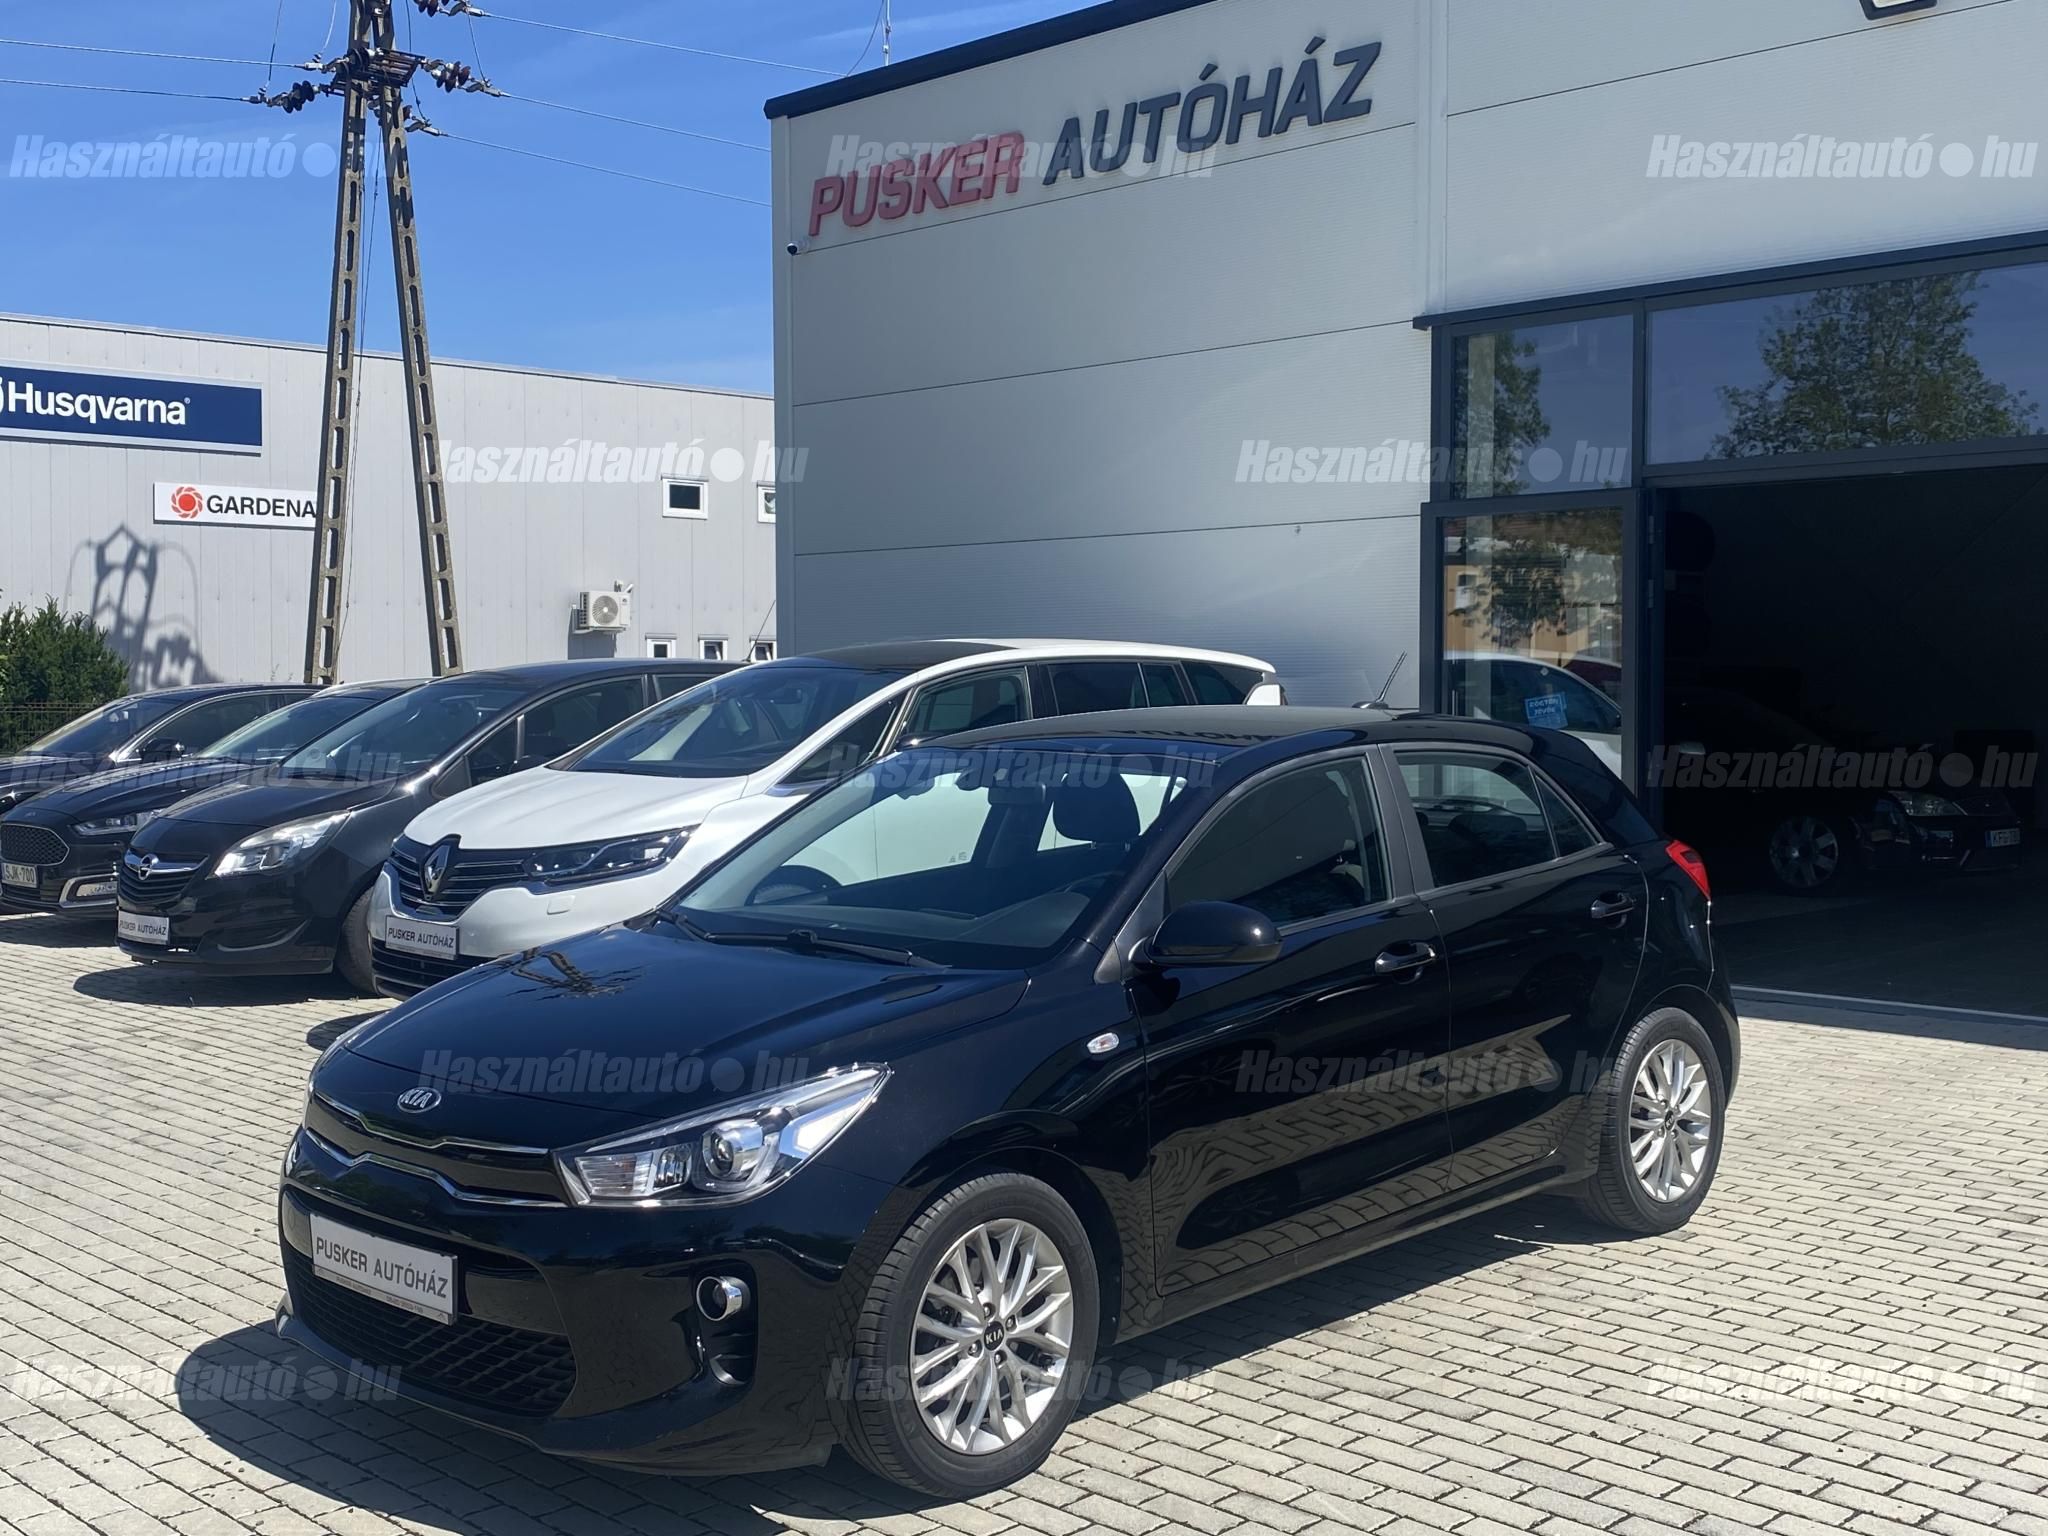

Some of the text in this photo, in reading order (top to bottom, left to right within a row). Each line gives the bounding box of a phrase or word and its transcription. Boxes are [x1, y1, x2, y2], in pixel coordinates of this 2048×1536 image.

[809, 37, 1382, 238] PUSKER AUTÓHÁZ
[207, 495, 316, 518] GARDENA
[5, 866, 35, 884] SJK-700
[119, 921, 136, 931] PUSKER
[388, 927, 454, 948] PUSKER AUTÓHÁZ
[400, 1089, 433, 1108] KIA
[316, 1237, 368, 1273] PUSKER
[374, 1259, 449, 1299] AUTÓHÁZ
[986, 1329, 1004, 1345] KIA
